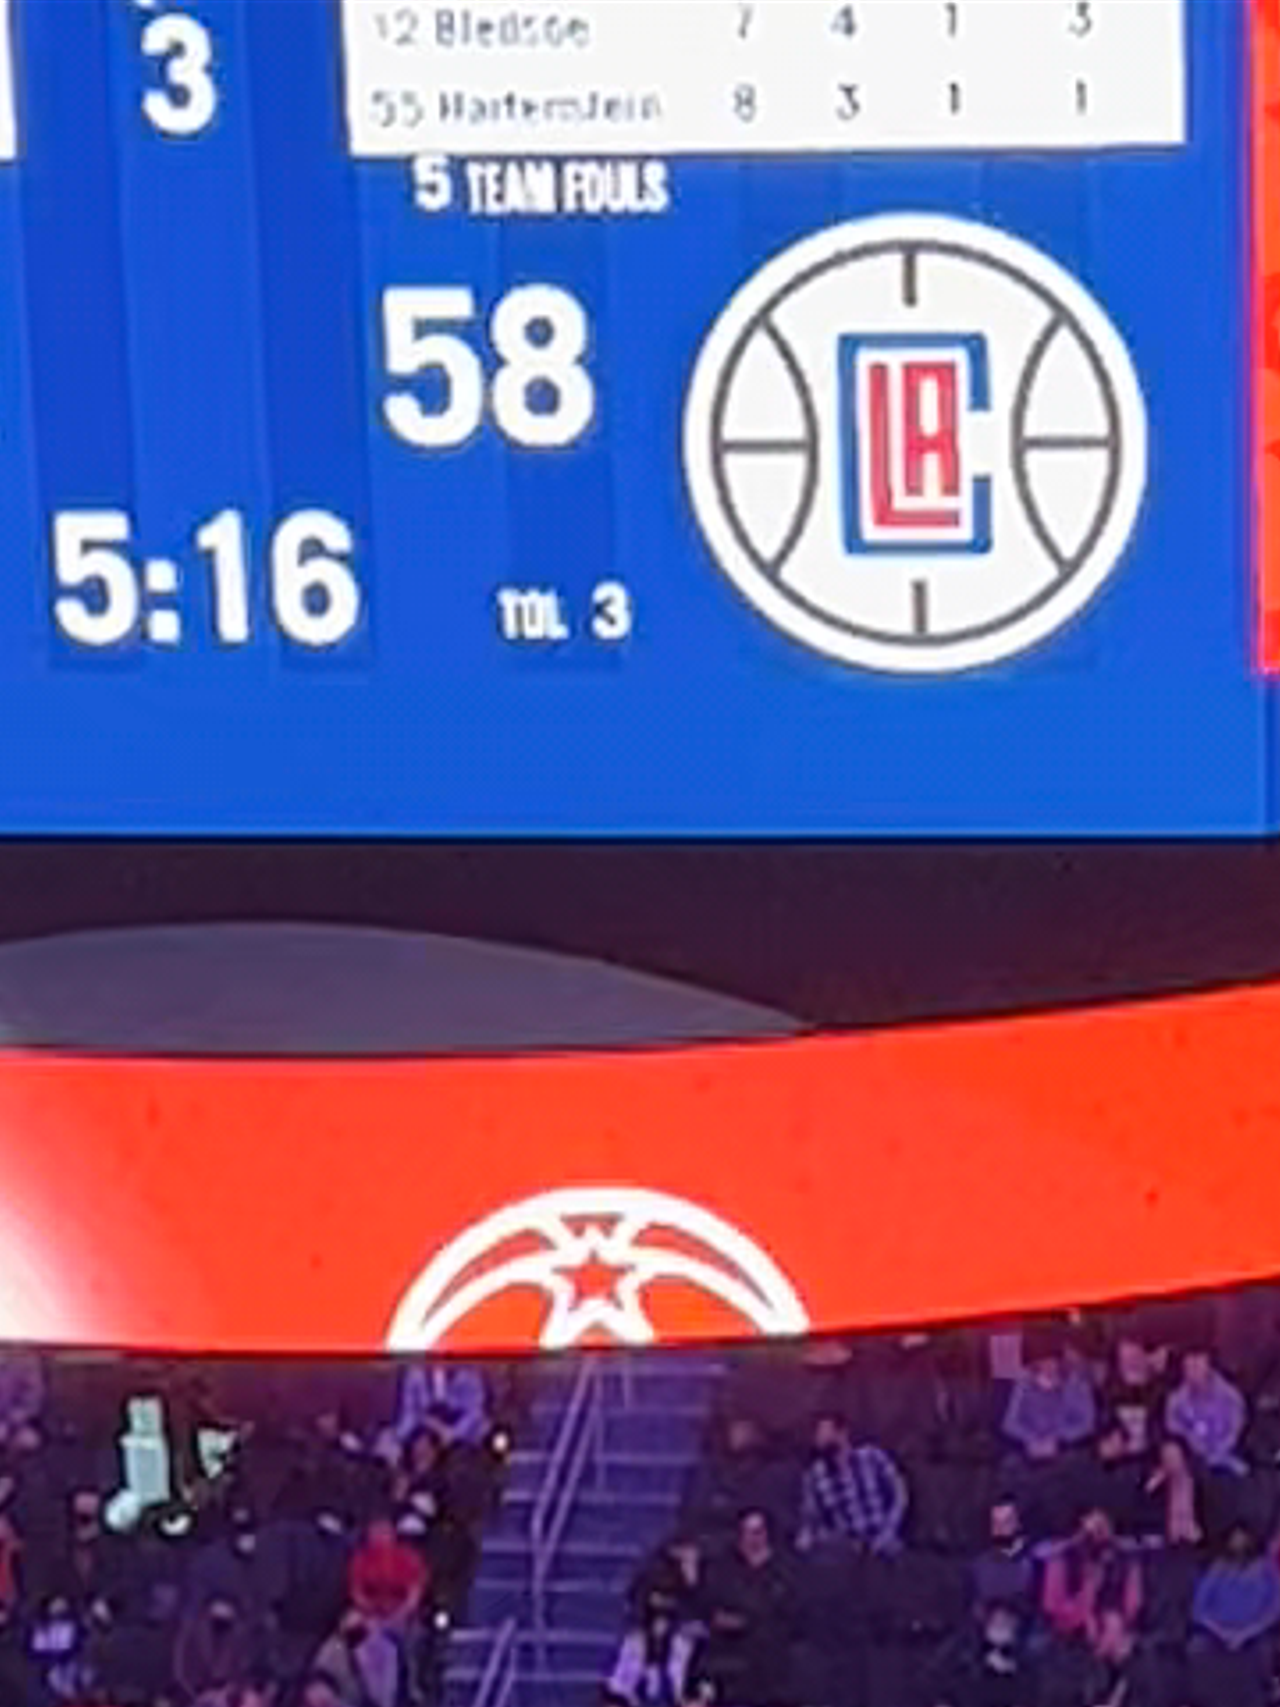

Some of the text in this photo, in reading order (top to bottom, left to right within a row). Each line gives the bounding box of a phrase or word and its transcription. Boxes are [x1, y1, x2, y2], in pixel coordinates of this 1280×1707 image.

[139, 13, 218, 136] 3
[835, 84, 862, 120] 3
[948, 82, 963, 116] 1
[1074, 82, 1088, 116] 1
[411, 155, 669, 214] 5 TEAM FOULS
[380, 284, 596, 450] 58
[53, 509, 361, 647] 5:16
[498, 583, 631, 639] TOL 3
